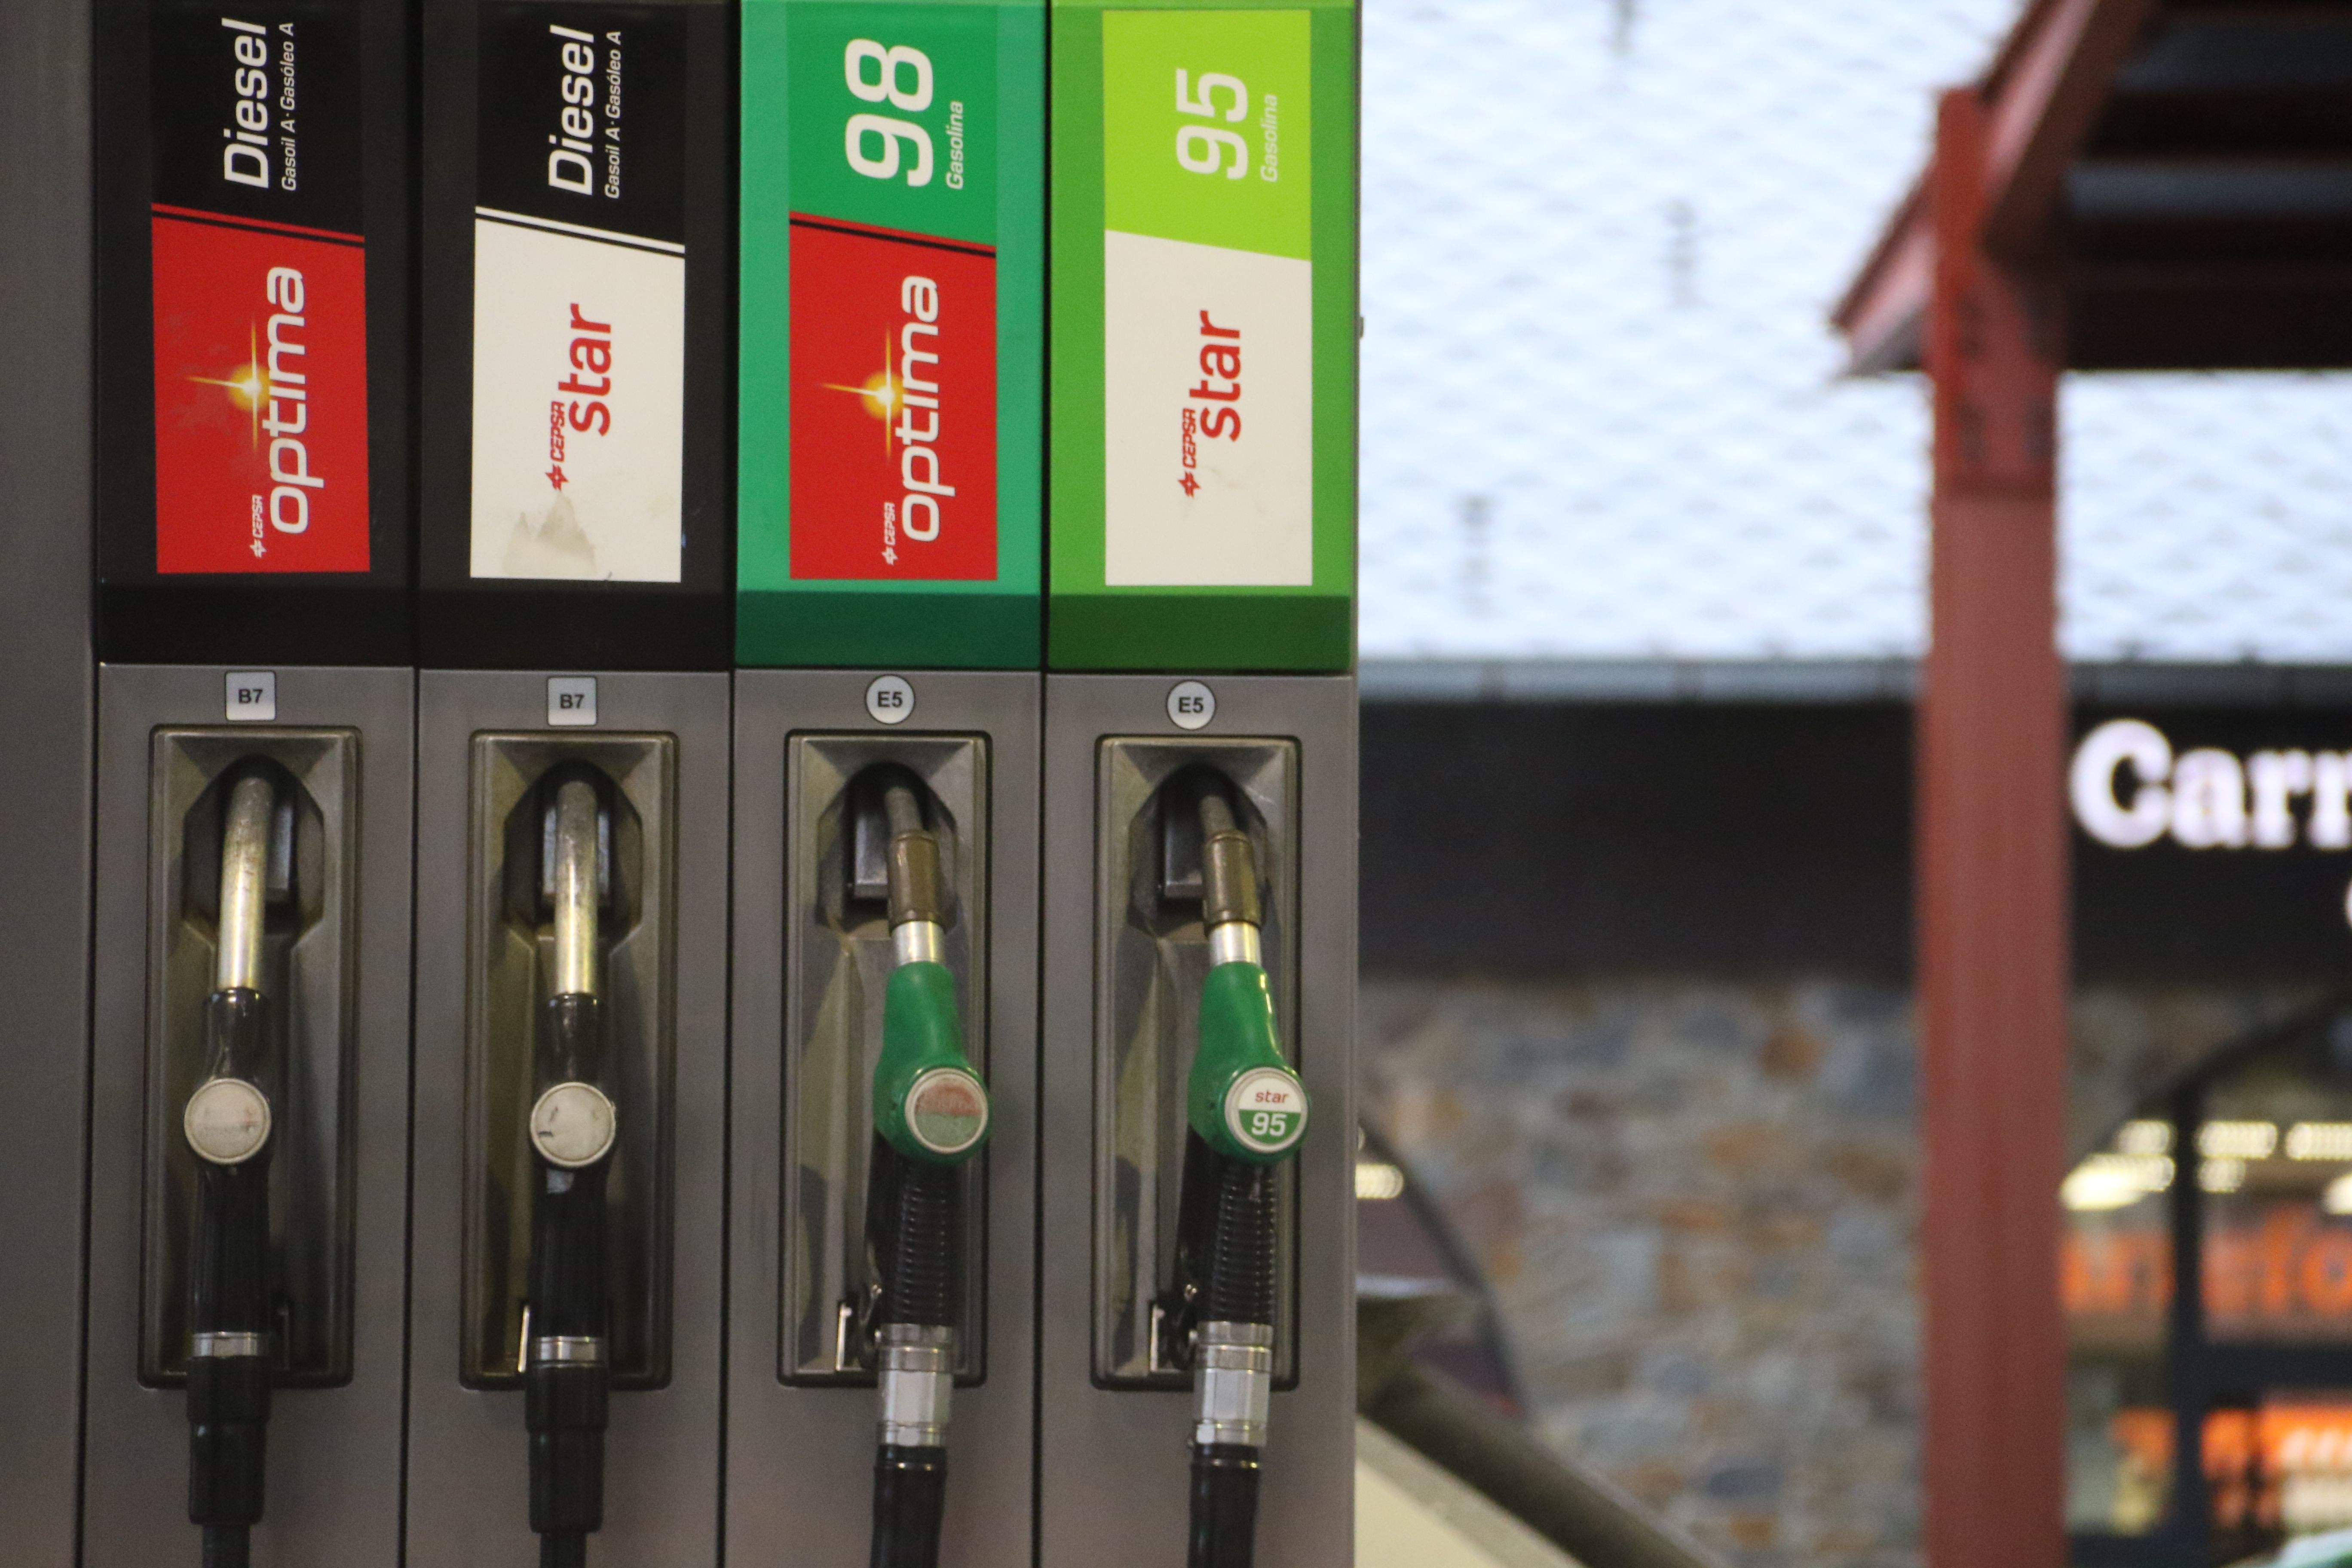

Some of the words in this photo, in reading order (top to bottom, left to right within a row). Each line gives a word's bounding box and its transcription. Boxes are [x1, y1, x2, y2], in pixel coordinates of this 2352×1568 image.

[279, 23, 294, 36] A
[606, 31, 621, 45] A
[221, 18, 269, 188] Diesel
[279, 42, 295, 111] Gasóleo
[605, 49, 621, 118] Gasóleo
[548, 24, 594, 196] Diesel
[845, 38, 933, 187] 98
[1176, 68, 1248, 180] 95
[1260, 94, 1277, 182] Gasolina
[281, 138, 297, 191] Gasoil
[604, 145, 620, 199] Gasoil
[946, 101, 963, 190] Gasolina
[262, 266, 324, 533] optima
[558, 303, 611, 436] star
[1189, 309, 1241, 442] star
[550, 401, 565, 462] CEPSA
[895, 276, 955, 542] optima
[1182, 407, 1196, 469] CEPSA
[252, 495, 263, 538] CEPSA
[884, 502, 895, 545] CEPSA
[237, 689, 263, 704] B7
[560, 694, 585, 709] B7
[877, 693, 903, 708] E5
[1179, 697, 1204, 713] E5
[1251, 1112, 1287, 1136] 95
[1255, 1090, 1289, 1103] star
